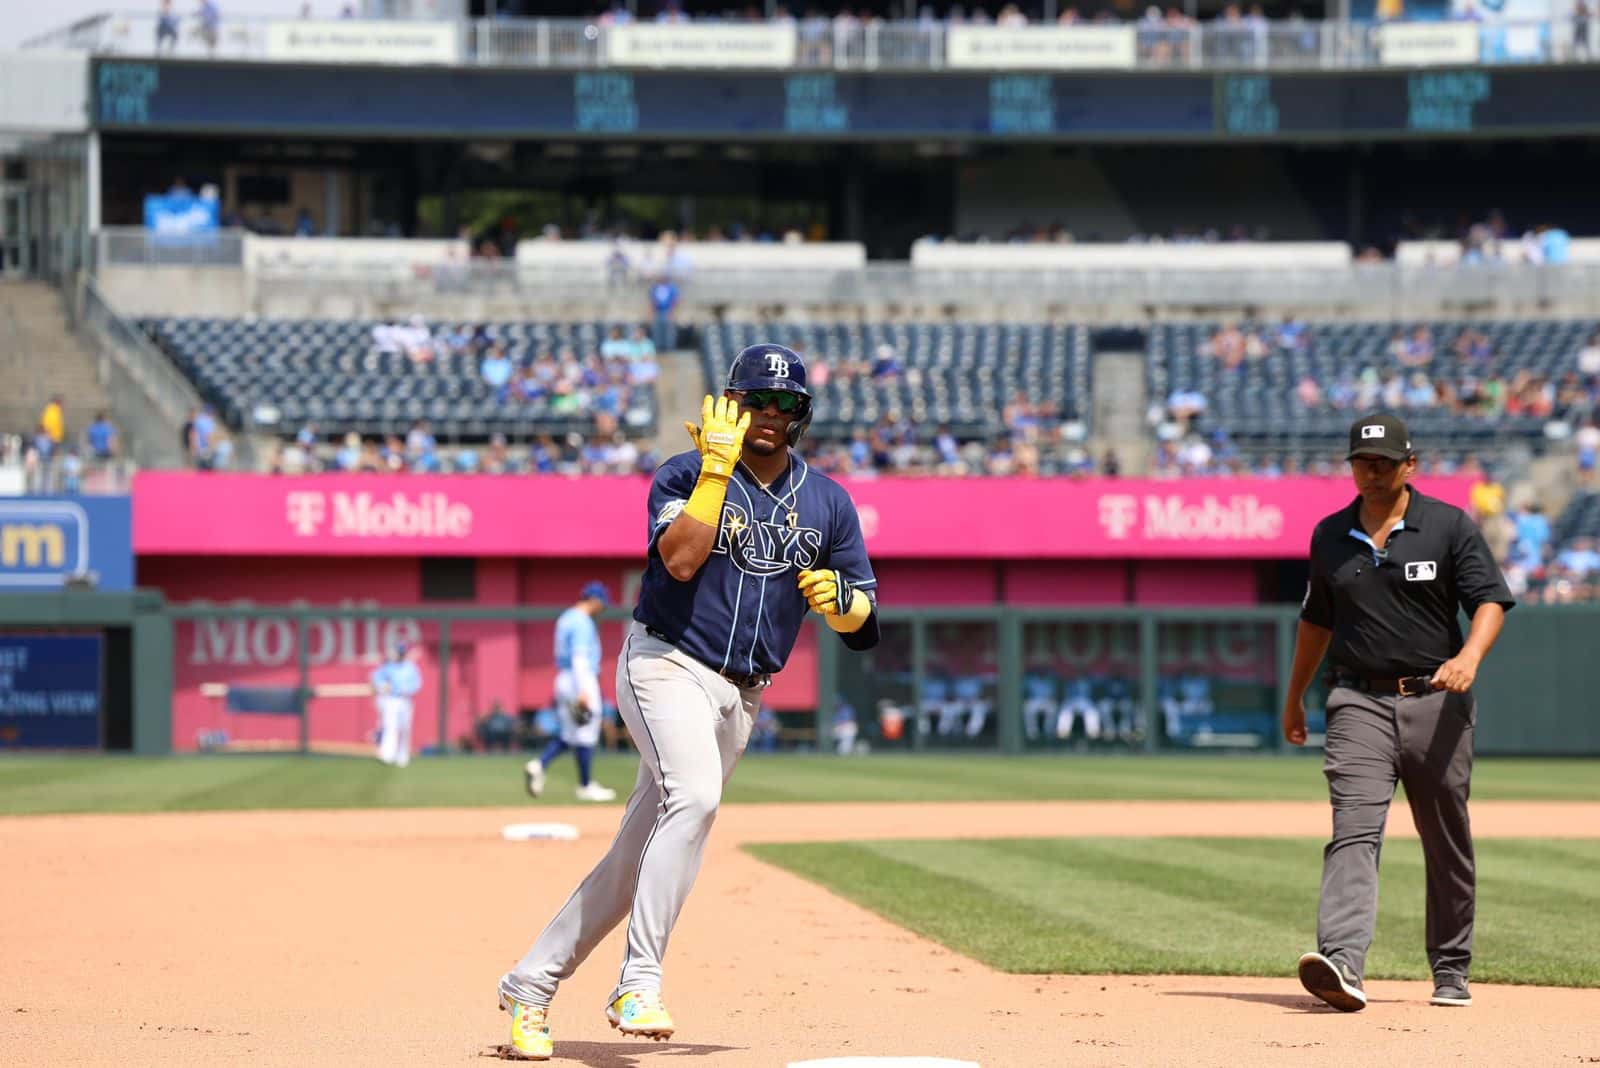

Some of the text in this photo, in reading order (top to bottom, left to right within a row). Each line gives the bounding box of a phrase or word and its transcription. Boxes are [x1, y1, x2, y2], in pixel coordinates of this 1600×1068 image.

[764, 353, 789, 378] TB
[331, 491, 473, 538] Mobile
[711, 500, 822, 575] RAYS
[1143, 494, 1284, 540] Mobile
